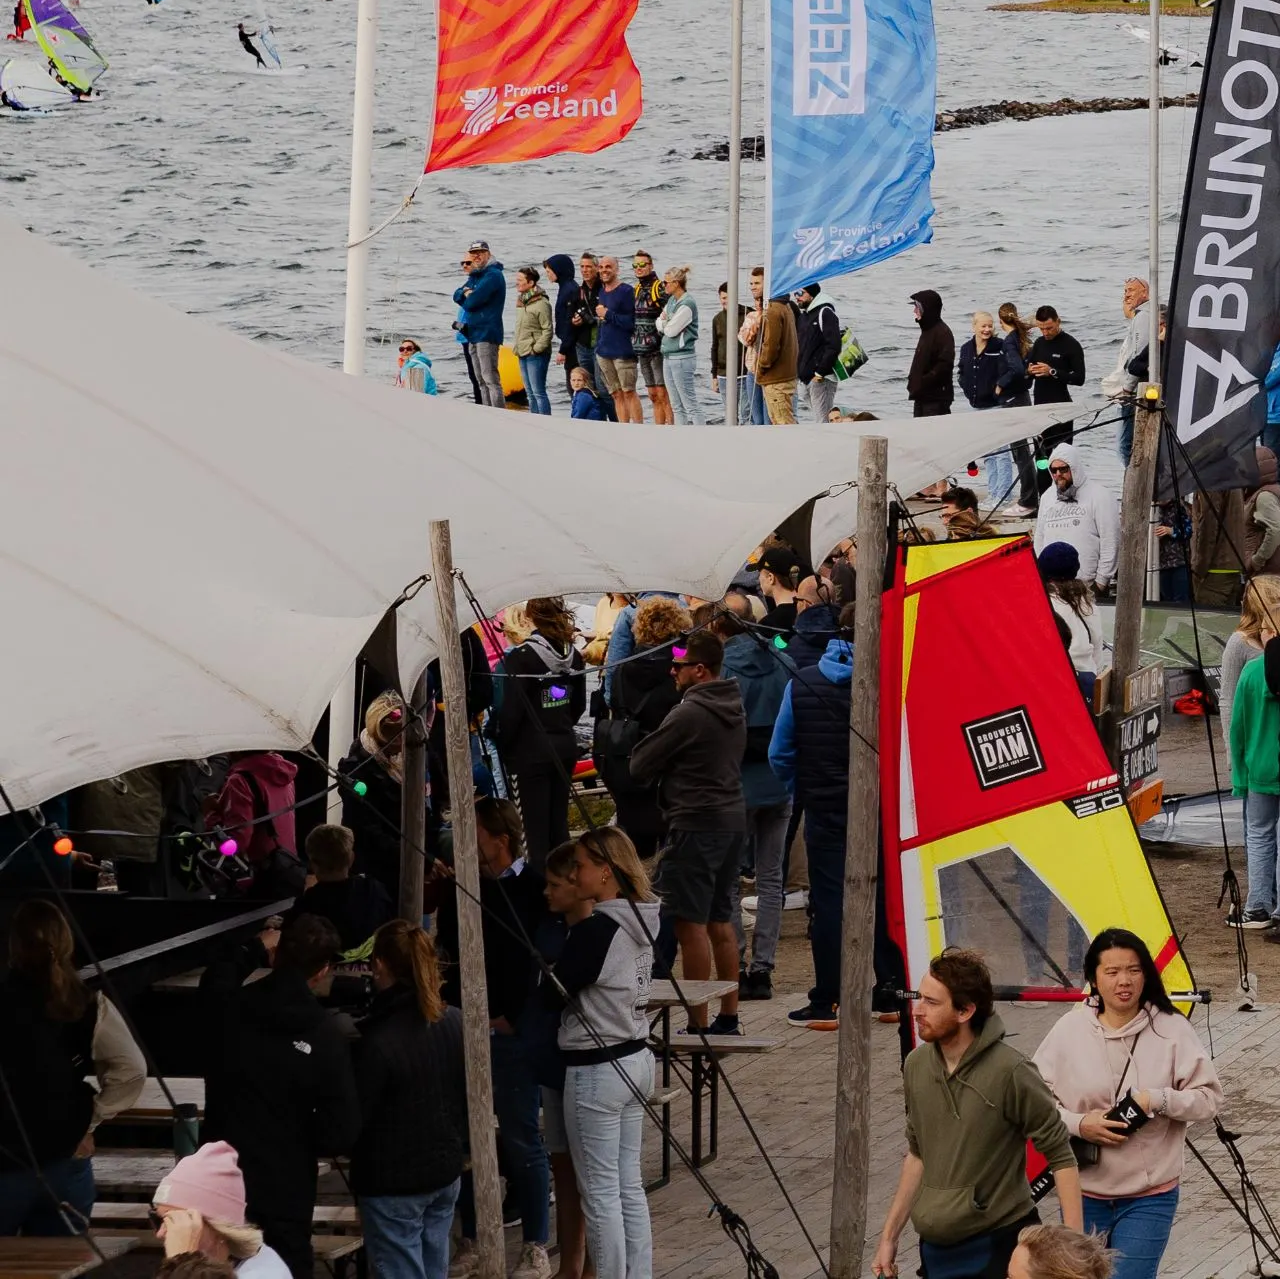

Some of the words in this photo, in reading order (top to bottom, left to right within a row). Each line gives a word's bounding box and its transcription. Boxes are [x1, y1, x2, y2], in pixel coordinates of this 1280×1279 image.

[504, 82, 569, 99] Provincie
[976, 723, 1022, 745] BROUWERS
[979, 731, 1029, 769] DAM
